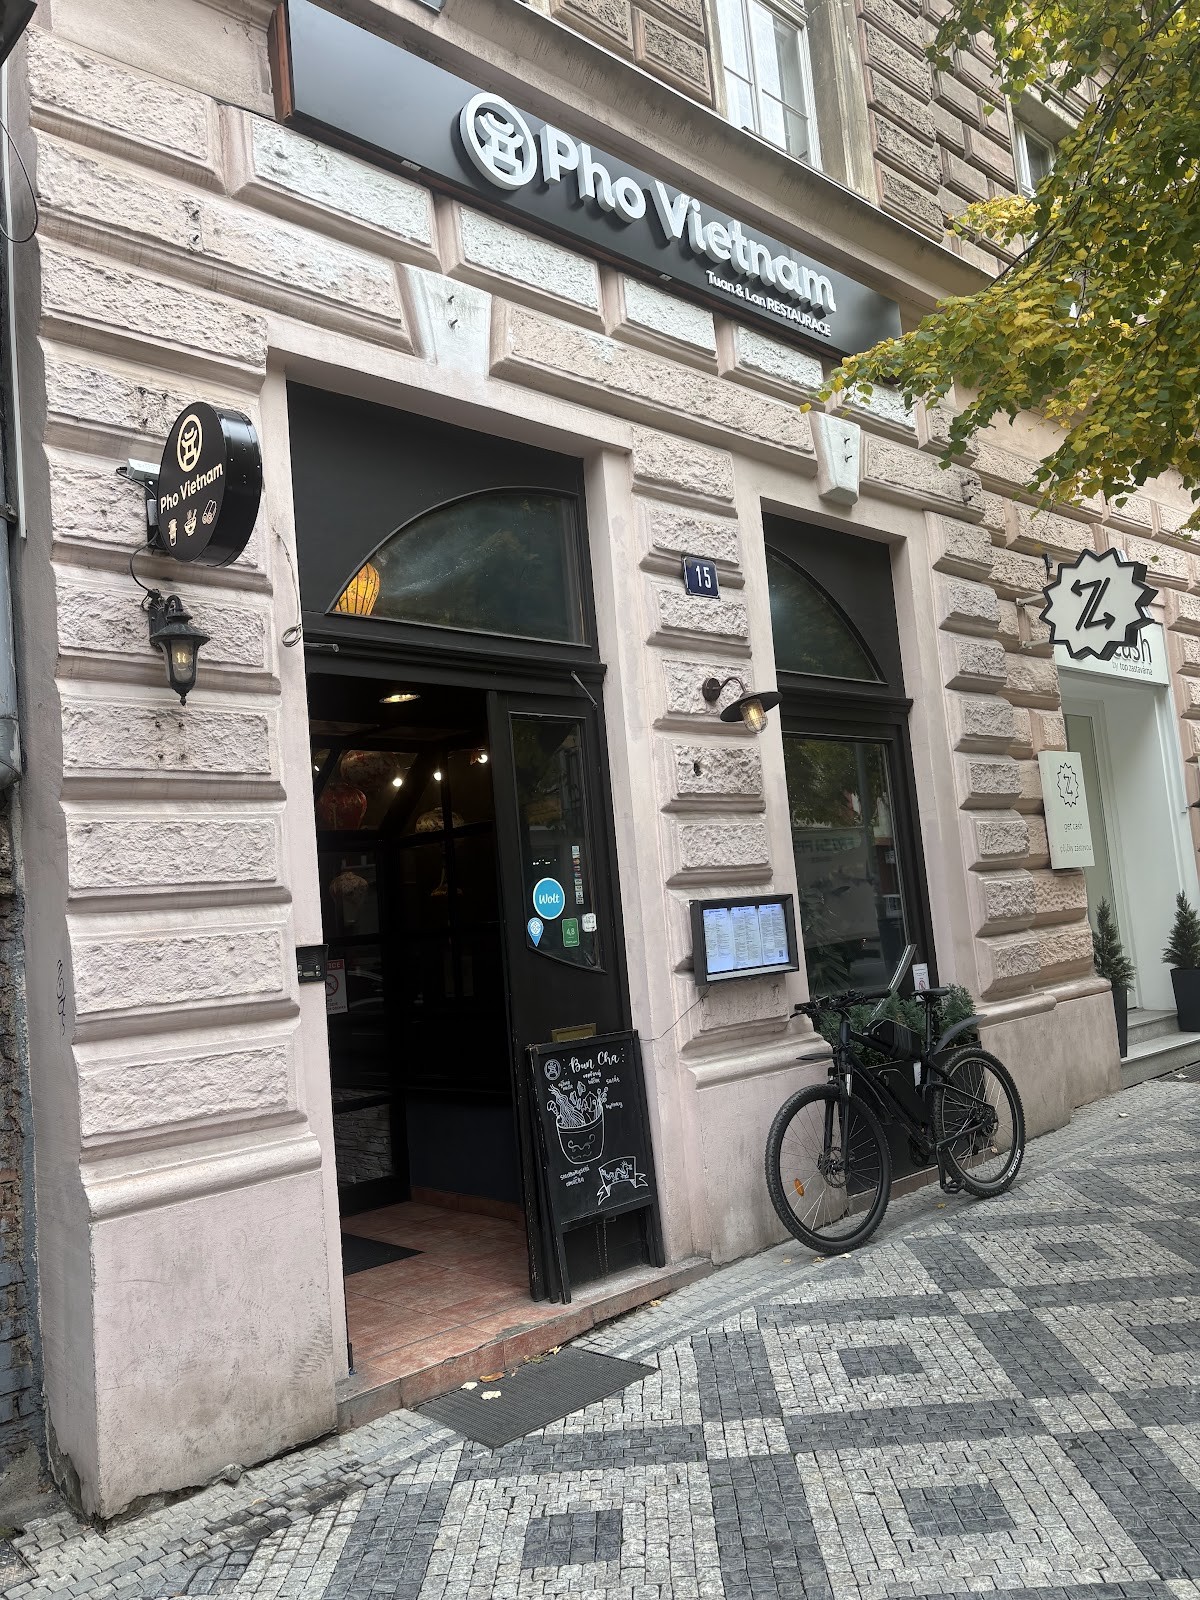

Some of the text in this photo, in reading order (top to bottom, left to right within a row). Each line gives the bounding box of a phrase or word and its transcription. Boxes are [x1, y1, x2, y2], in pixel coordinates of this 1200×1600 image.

[540, 124, 837, 315] Pho Vietnam
[706, 269, 832, 338] Tuan & Lan RESTAURACE
[160, 463, 224, 514] Pho Vietnam
[695, 565, 712, 589] 15
[1120, 663, 1129, 674] top
[538, 893, 560, 905] Wolt
[569, 1051, 620, 1074] Bun Cha
